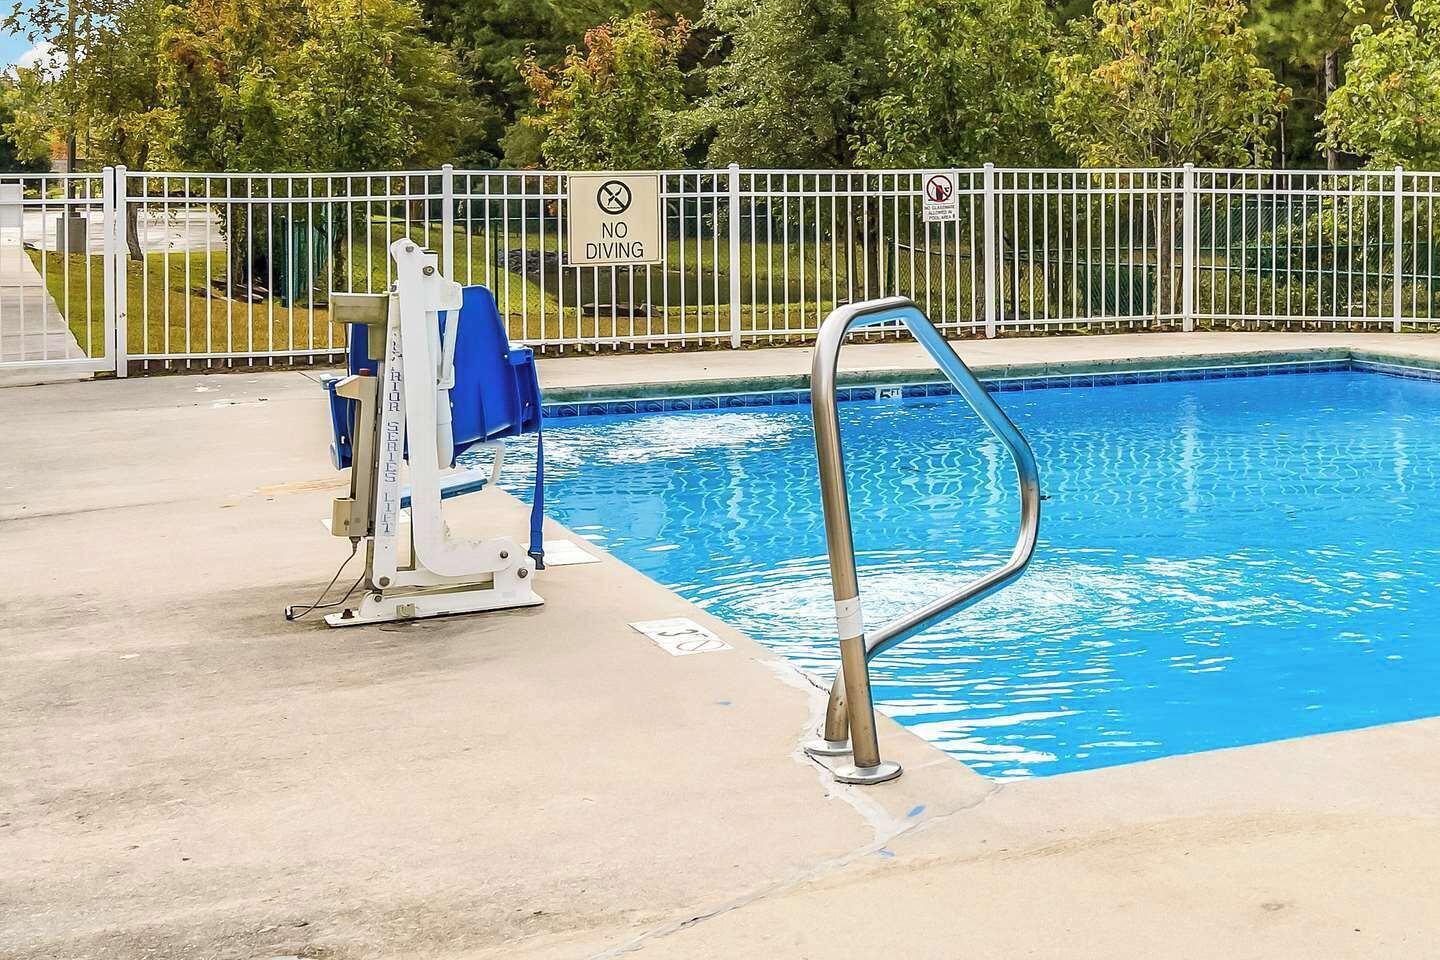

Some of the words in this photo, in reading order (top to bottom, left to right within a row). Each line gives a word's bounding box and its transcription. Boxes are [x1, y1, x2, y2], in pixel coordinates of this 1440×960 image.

[602, 222, 628, 239] NO
[586, 241, 644, 259] DIVING
[384, 421, 400, 482] SERIES
